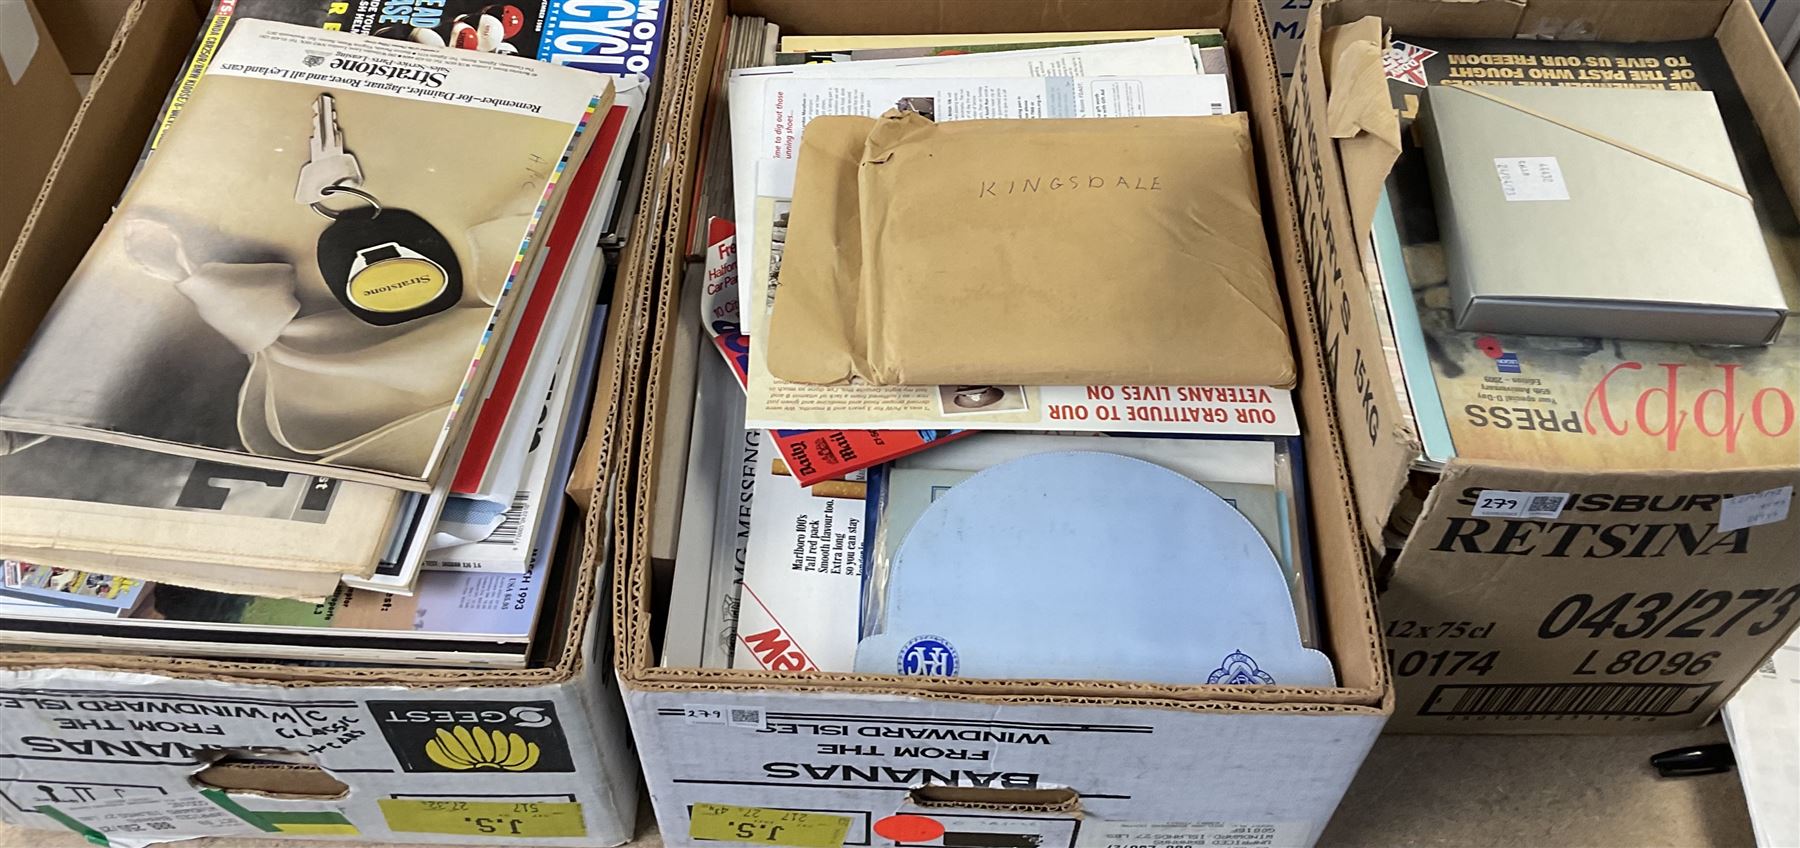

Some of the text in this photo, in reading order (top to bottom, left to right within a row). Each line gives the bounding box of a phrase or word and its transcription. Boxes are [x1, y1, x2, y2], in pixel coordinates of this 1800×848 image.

[550, 0, 636, 77] CYCL
[221, 62, 245, 72] cars
[244, 64, 289, 78] Leyland
[1447, 54, 1692, 68] TO GIVE US OUR FREEDOM
[290, 70, 305, 80] all
[330, 58, 447, 88] Stratstone
[1448, 67, 1695, 80] OF THE PAST WHO FOUGHT
[363, 79, 406, 94] Jaguar,
[407, 86, 455, 101] Daimler,
[775, 91, 784, 109] those
[774, 123, 785, 135] dig
[775, 136, 783, 144] to
[785, 135, 795, 160] unning
[979, 175, 1162, 199] KINGSDALE
[718, 243, 736, 260] Fre
[362, 274, 431, 297] Stratstone
[707, 281, 724, 295] Car
[1480, 384, 1531, 395] Anniversary
[1511, 377, 1542, 386] Edition
[1086, 386, 1272, 404] VETERANS LIVES ON
[1477, 392, 1504, 402] D-Day
[1504, 394, 1536, 402] special
[1047, 404, 1277, 424] OUR GRATITUDE TO OUR
[1583, 361, 1795, 454] oppy
[1464, 404, 1584, 434] PRESS
[829, 432, 857, 462] Mail
[790, 441, 817, 477] Daily
[1481, 498, 1518, 509] 279
[792, 513, 808, 571] Marlboro 100's
[804, 519, 821, 572] Tall red pack
[818, 499, 835, 574] Smooth flavour too.
[845, 517, 860, 576] so you can stay
[1429, 516, 1752, 557] RETSINA
[830, 533, 846, 575] Extra long
[514, 586, 529, 610] 1993
[1537, 585, 1799, 641] 043/273
[744, 628, 814, 671] ew
[908, 646, 949, 677] RAC
[0, 697, 269, 720] WINDWARD ISLE
[384, 709, 507, 723] GEEST
[688, 709, 721, 718] 279
[53, 718, 226, 736] FROM THE
[276, 716, 360, 739] CLASSIC
[756, 722, 1052, 745] WINDWARD ISLES
[19, 736, 221, 759] NANAS
[817, 744, 989, 760] FROM THE
[763, 762, 1039, 789] BANANAS
[513, 802, 539, 813] 517
[781, 812, 807, 822] 217
[463, 817, 523, 835] J.S.
[727, 821, 784, 841] J.S.
